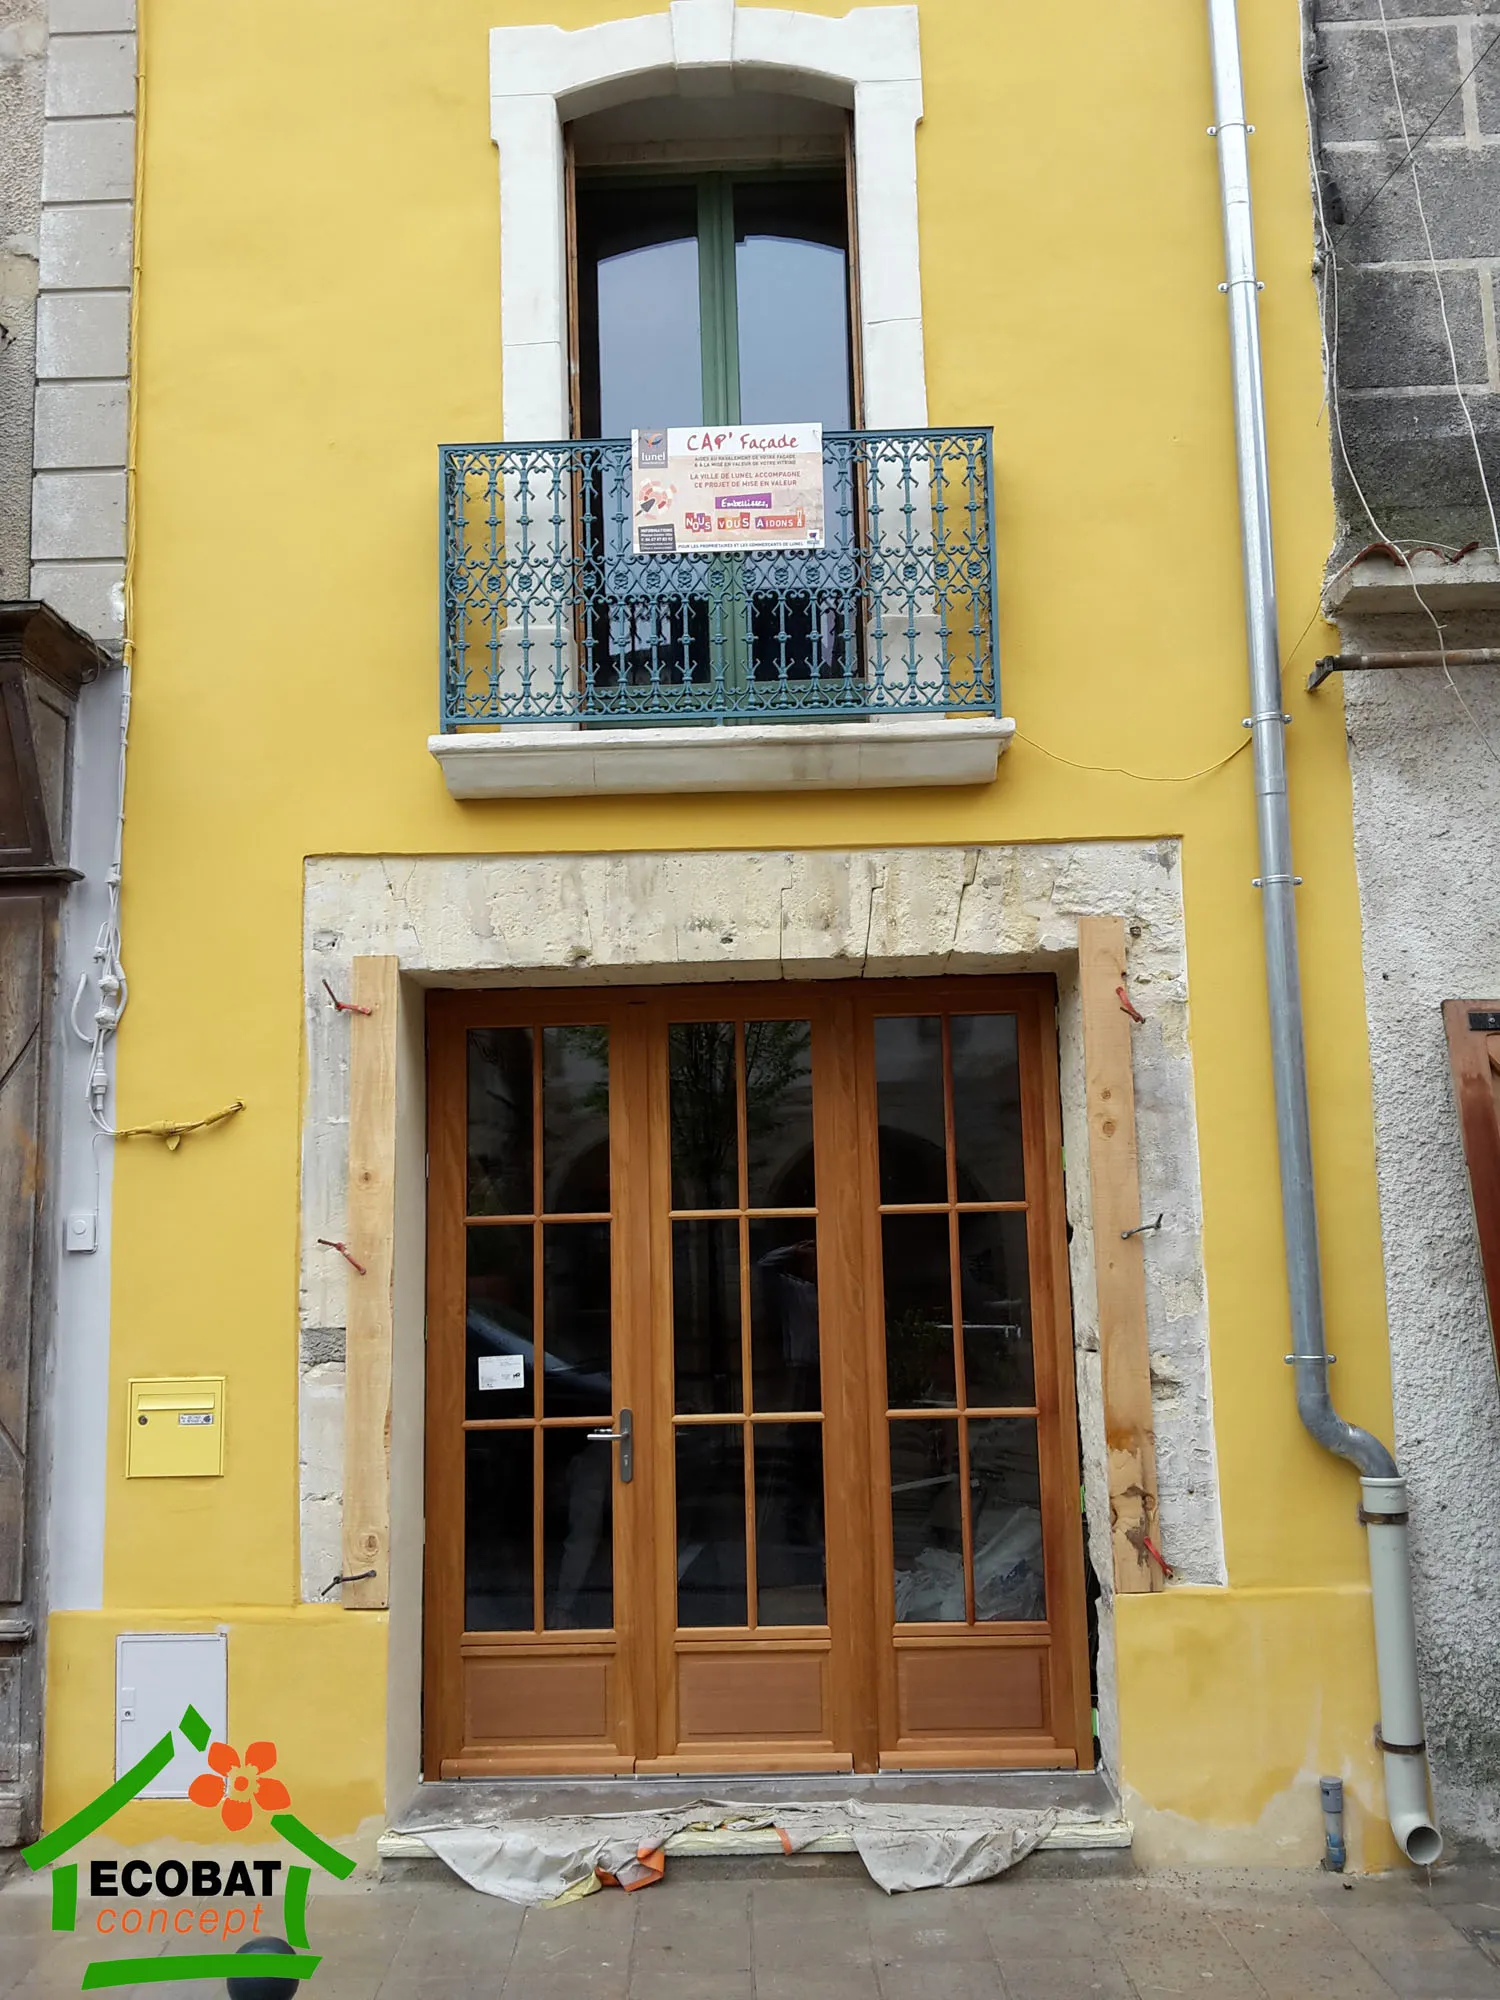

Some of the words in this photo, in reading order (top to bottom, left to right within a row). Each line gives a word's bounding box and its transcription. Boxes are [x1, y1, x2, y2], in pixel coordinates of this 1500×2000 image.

[687, 432, 733, 451] CAP'
[740, 434, 799, 452] Façade
[641, 452, 666, 461] lunel
[686, 513, 711, 530] NOUS
[757, 519, 793, 527] AIDONS
